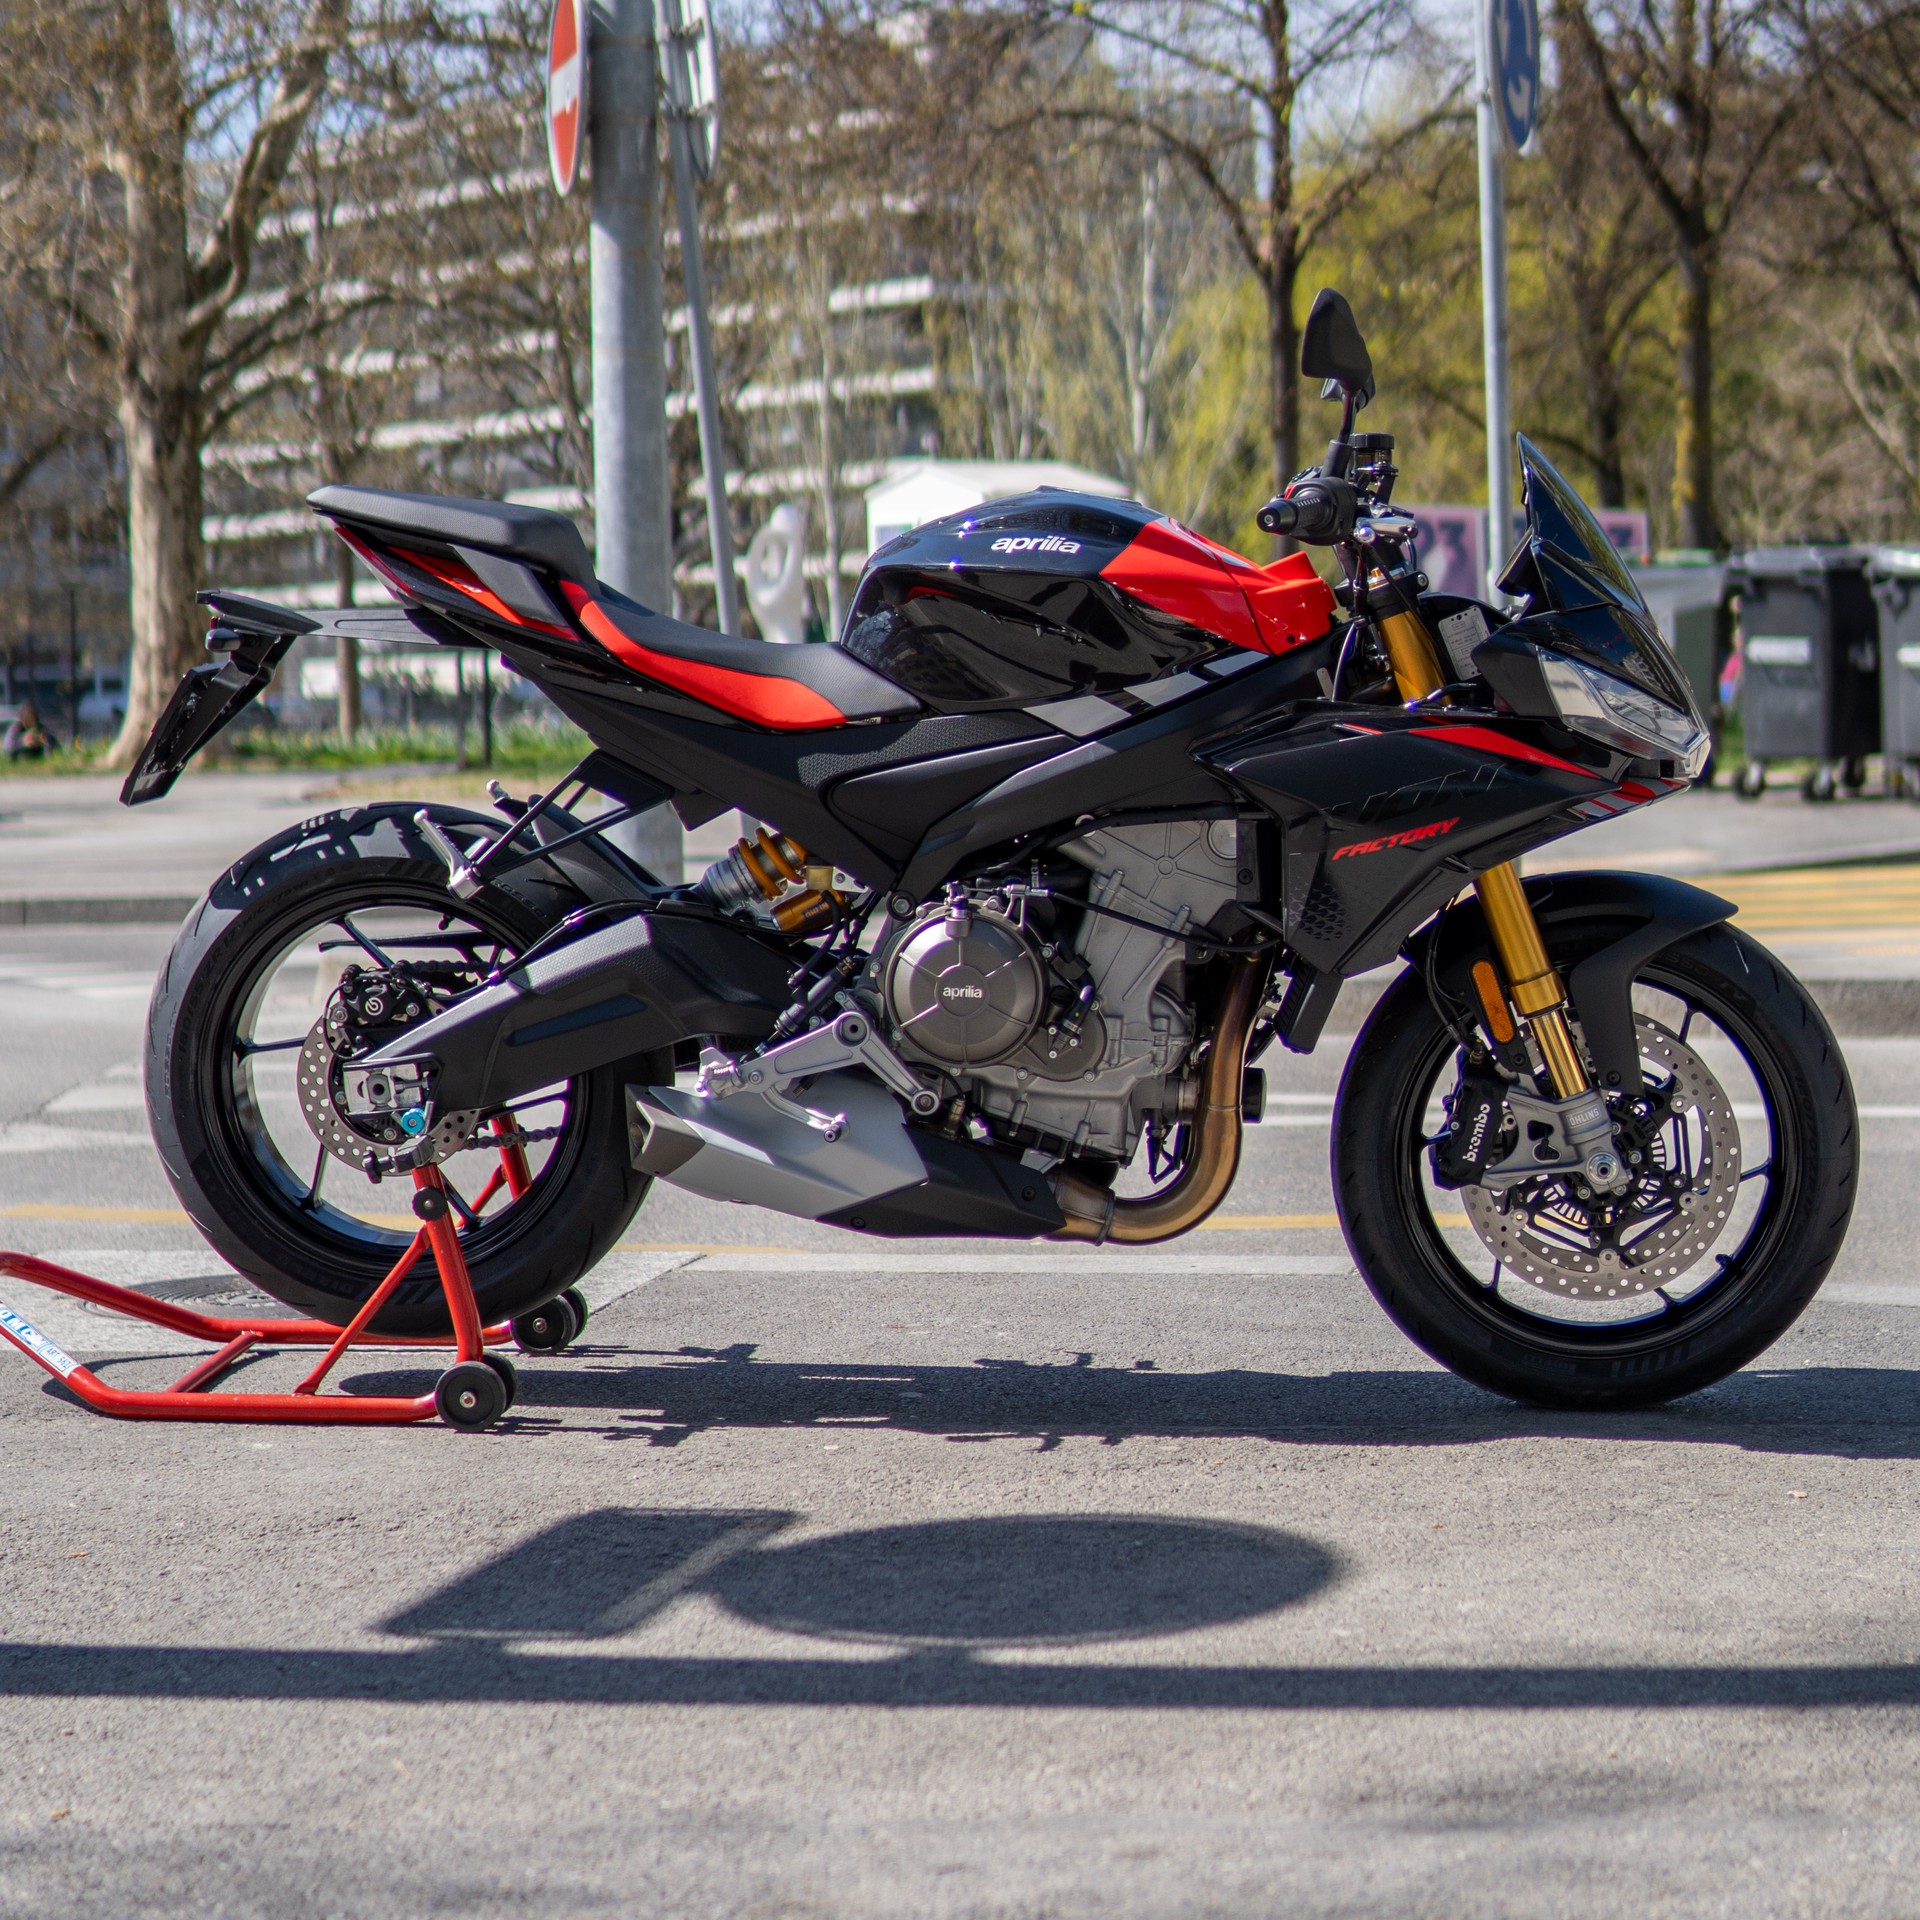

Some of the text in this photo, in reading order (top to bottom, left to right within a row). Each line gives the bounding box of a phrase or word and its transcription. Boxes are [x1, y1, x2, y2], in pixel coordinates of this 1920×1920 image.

[990, 535, 1081, 554] aprilia
[1332, 817, 1460, 861] FACTORY
[943, 985, 982, 1000] aprilia
[1462, 1103, 1491, 1162] brembo
